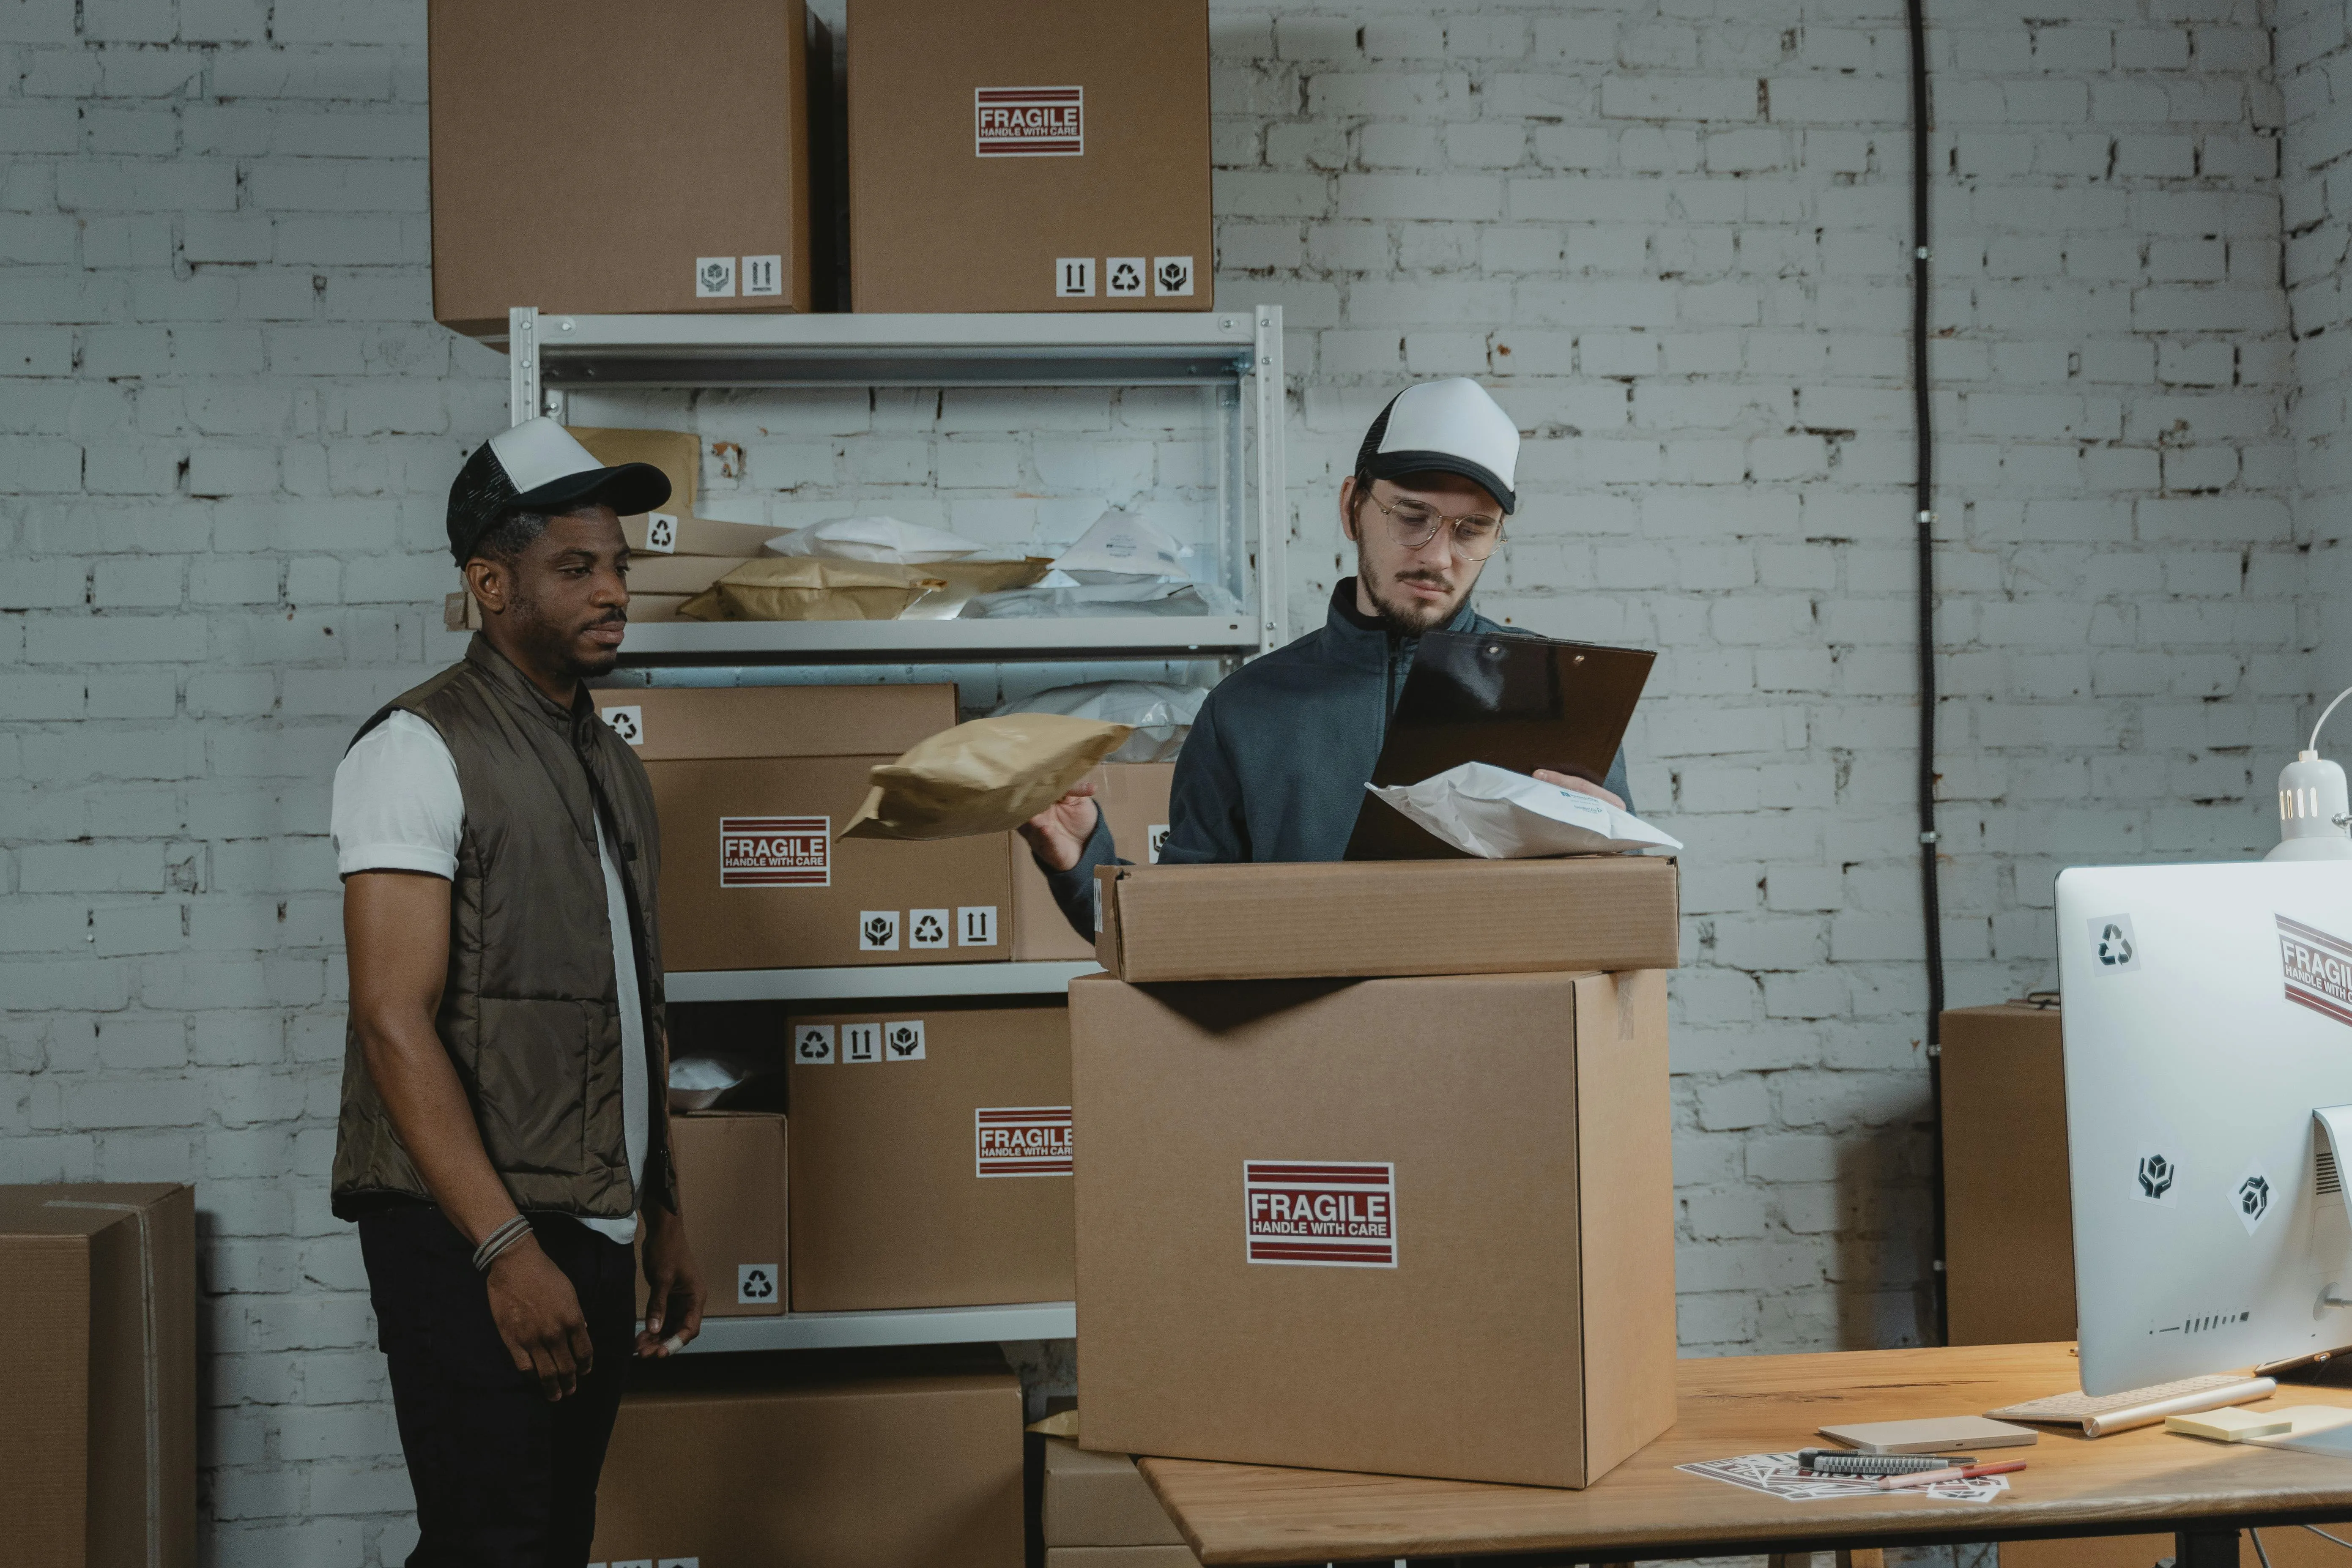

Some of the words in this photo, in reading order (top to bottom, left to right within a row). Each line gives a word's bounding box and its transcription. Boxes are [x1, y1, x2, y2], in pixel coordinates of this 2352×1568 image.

[980, 108, 1078, 128] FRAGILE
[981, 127, 1021, 136] HANDLE
[1023, 127, 1048, 136] WITH
[1050, 126, 1078, 136] CARE
[724, 838, 824, 857] FRAGILE
[726, 857, 767, 866] HANDLE
[769, 857, 794, 866] WITH
[796, 857, 824, 866] CARE
[2282, 939, 2352, 991] FRAGIL
[2285, 965, 2322, 989] HANDLE
[2324, 981, 2346, 1000] WITH
[980, 1128, 1073, 1147] FRAGILE
[981, 1147, 1021, 1157] HANDLE
[1023, 1147, 1048, 1156] WITH
[1050, 1146, 1073, 1156] CAR
[1251, 1193, 1387, 1223] FRAGILE
[1253, 1220, 1308, 1234] HANDLE
[1311, 1223, 1345, 1235] WITH
[1348, 1223, 1387, 1236] CARE
